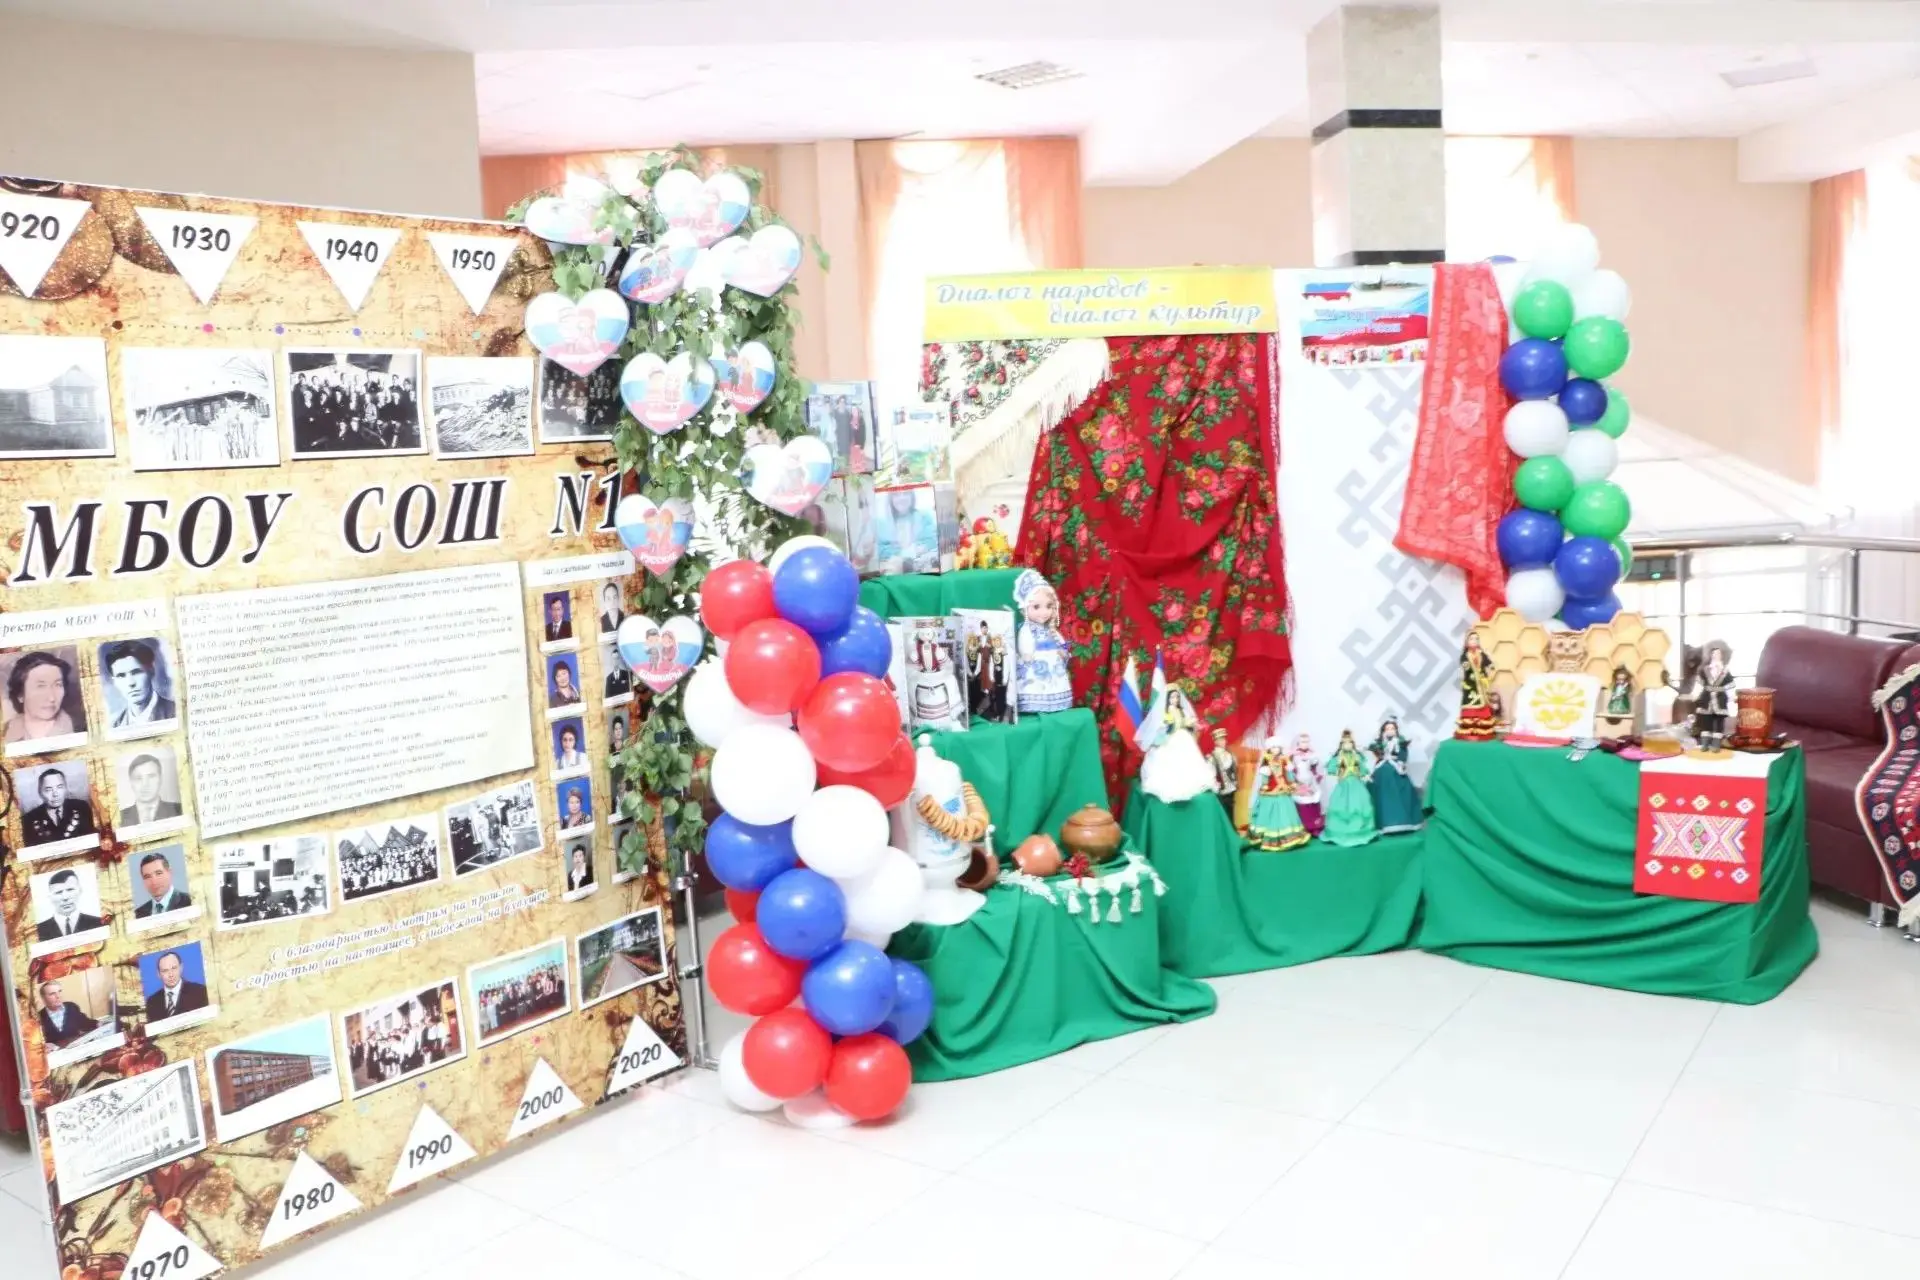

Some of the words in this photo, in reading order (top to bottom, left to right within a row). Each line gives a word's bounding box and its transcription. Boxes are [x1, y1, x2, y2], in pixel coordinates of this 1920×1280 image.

[1, 212, 60, 241] 920
[172, 225, 231, 252] 1930
[326, 238, 379, 263] 1940
[452, 249, 496, 271] 1950
[937, 284, 1032, 303] Диалог
[1043, 276, 1149, 304] народов
[1050, 305, 1139, 325] диалог
[1149, 300, 1262, 326] культур
[13, 492, 293, 583] МБОУ
[344, 479, 507, 554] СОШ
[0, 620, 57, 637] ректора
[64, 614, 98, 628] МБОУ
[106, 610, 136, 623] СОШ
[286, 924, 389, 958] благодарностью
[394, 908, 448, 930] смотрим
[453, 902, 467, 912] на
[471, 885, 517, 907] прошлое
[249, 963, 319, 987] гордостью
[325, 957, 339, 968] на
[488, 907, 501, 918] на
[620, 1043, 663, 1075] 2020
[520, 1087, 565, 1121] 2000
[407, 1134, 453, 1169] 1990
[283, 1181, 336, 1221] 1980
[129, 1245, 190, 1280] 1970
